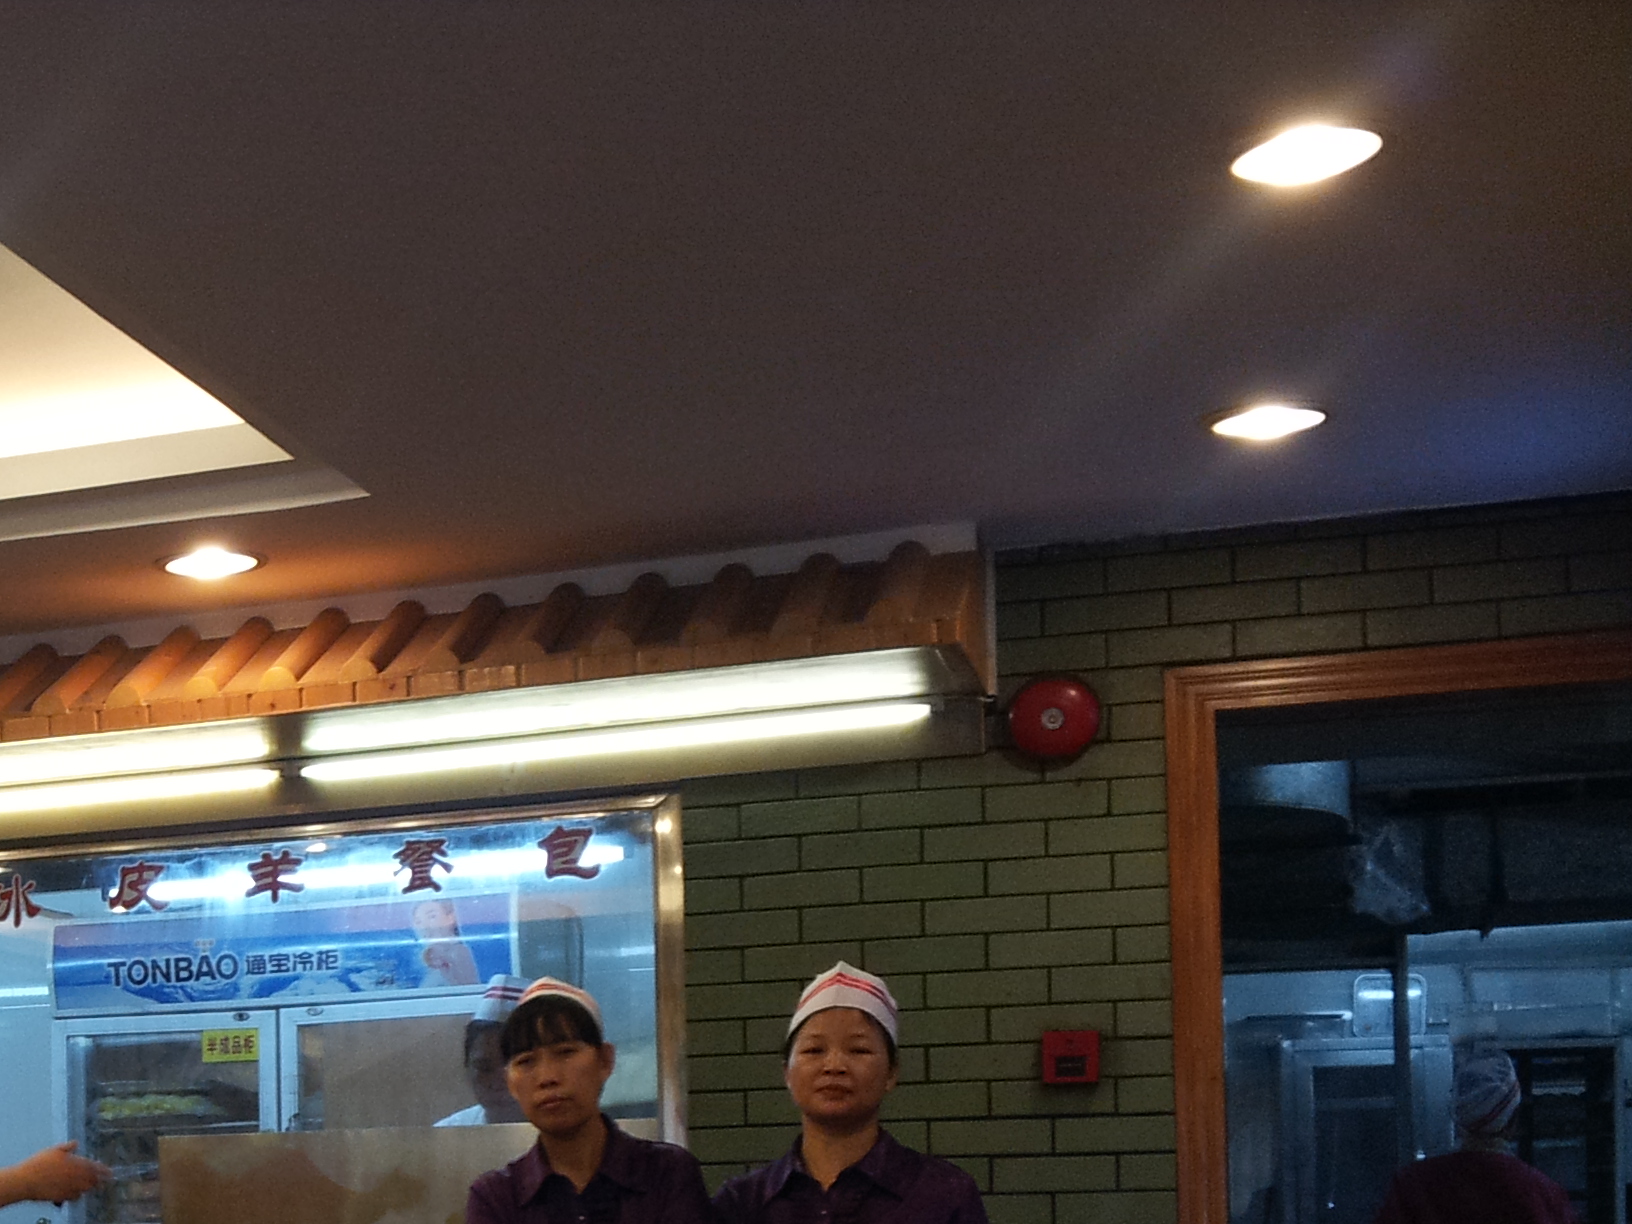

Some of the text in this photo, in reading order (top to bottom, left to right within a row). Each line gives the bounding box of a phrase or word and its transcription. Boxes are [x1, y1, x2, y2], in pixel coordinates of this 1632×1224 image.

[107, 949, 339, 988] TONBAO 通宝冷柜
